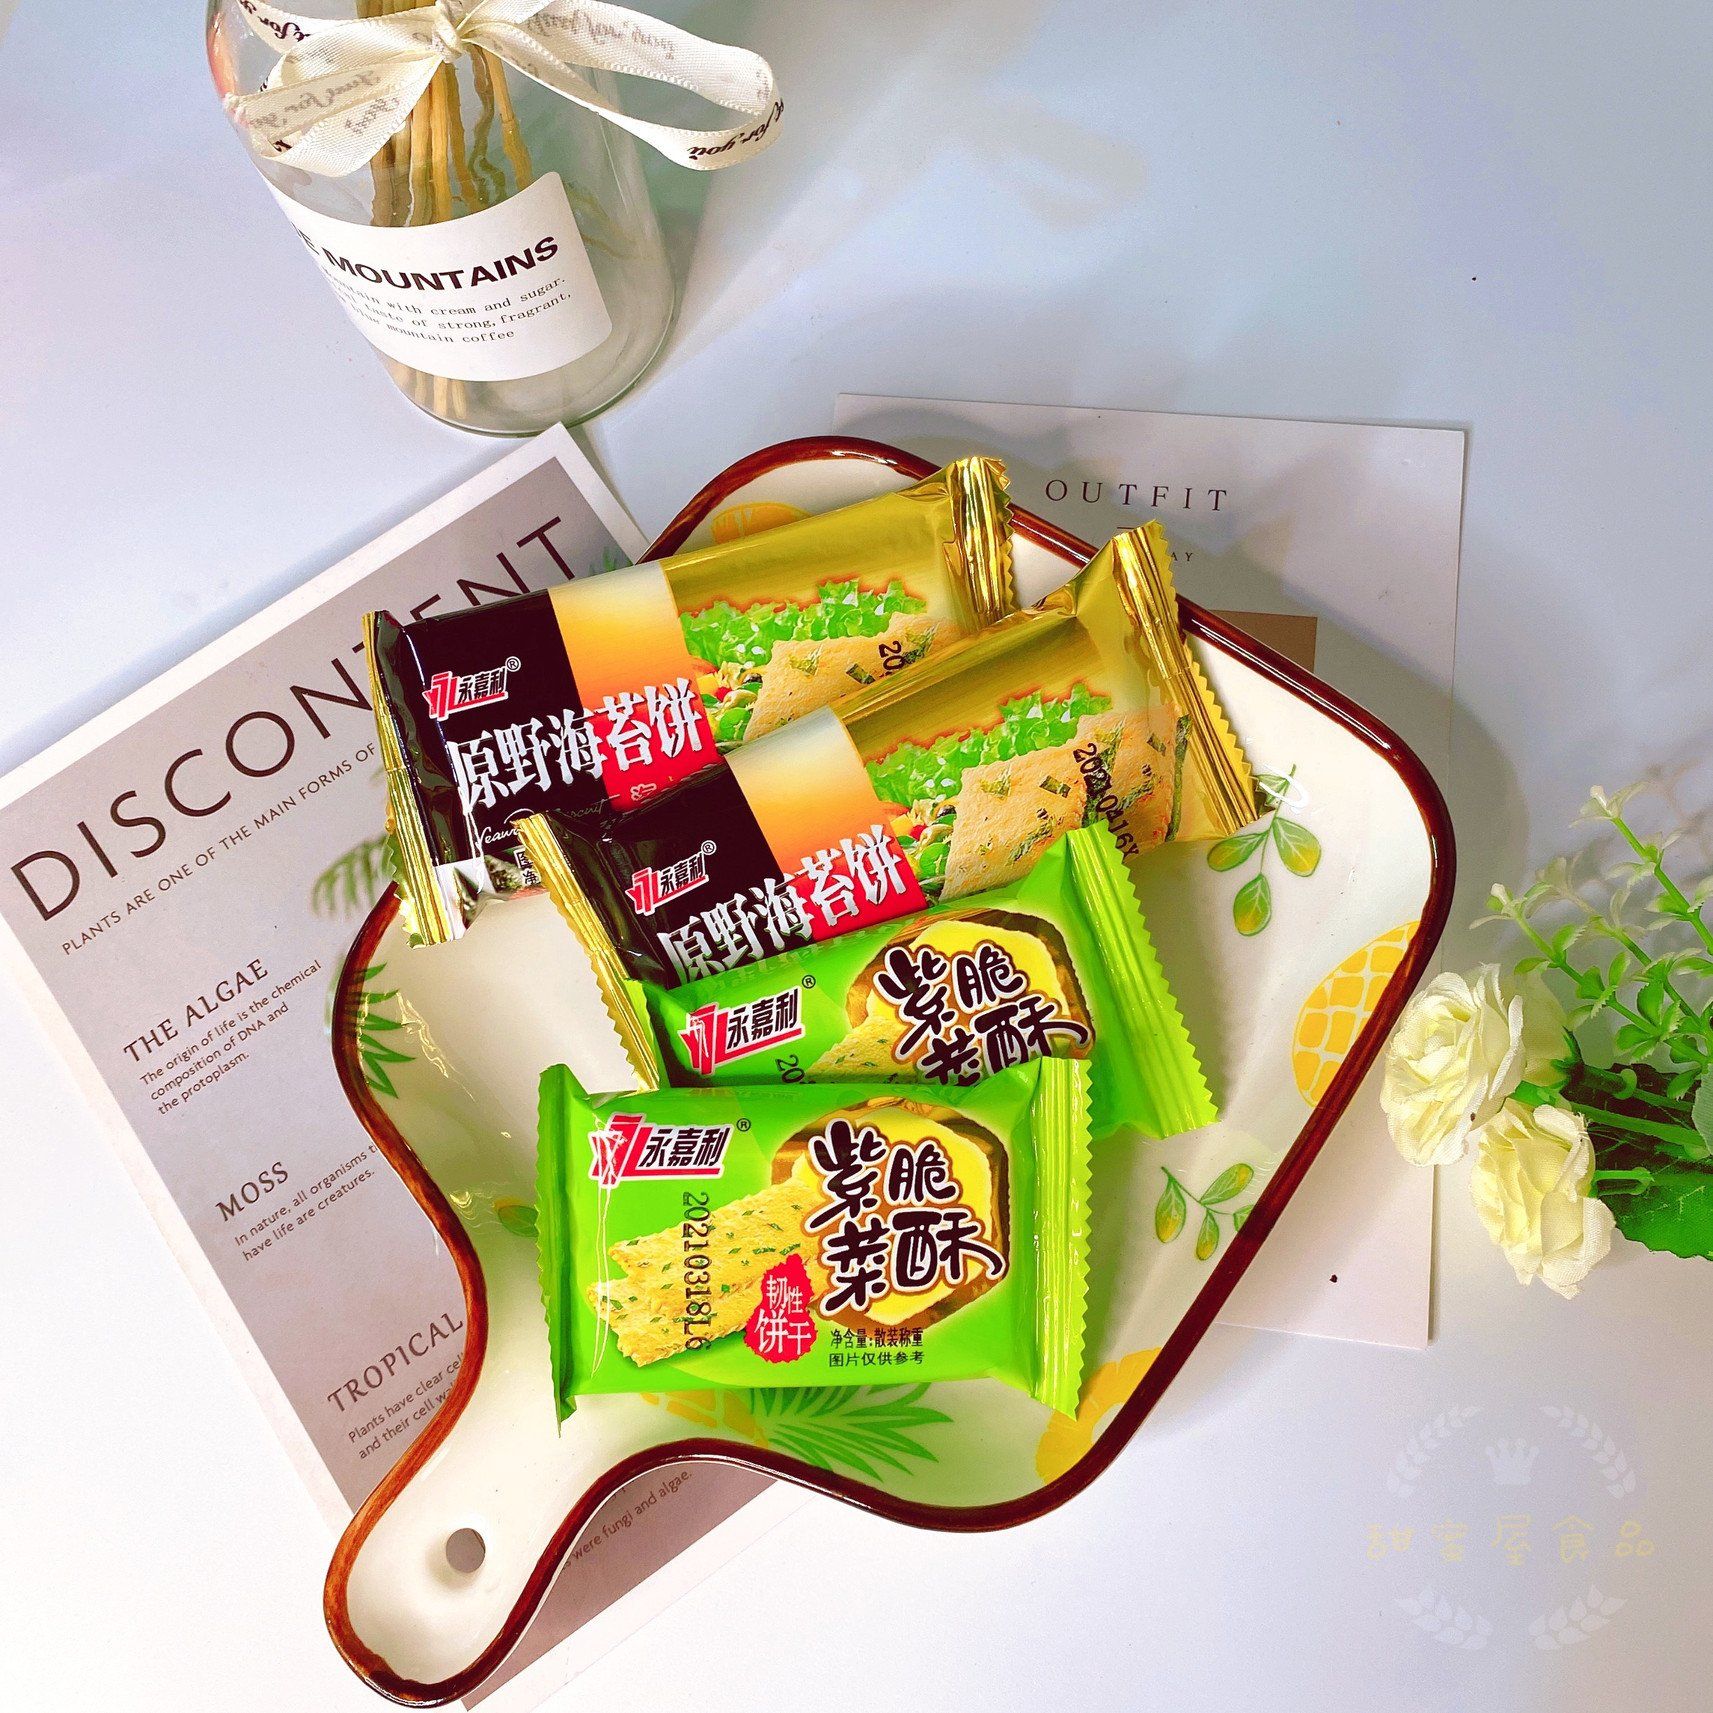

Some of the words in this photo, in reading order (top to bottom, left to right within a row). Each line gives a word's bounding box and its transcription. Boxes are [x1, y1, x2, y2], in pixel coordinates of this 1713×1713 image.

[322, 236, 559, 291] MOUNTAINS
[387, 302, 422, 314] with
[430, 306, 477, 316] cream
[484, 298, 511, 312] and
[520, 278, 566, 303] sugar.
[411, 318, 428, 327] of
[387, 323, 454, 343] mountain
[462, 330, 515, 343] coffee
[1045, 478, 1230, 513] OUTFIT
[457, 666, 507, 705] 永嘉利
[446, 677, 703, 815] 原野海苔饼
[61, 910, 122, 956] PLANTS
[126, 888, 156, 915] ARE
[158, 863, 194, 892] ONE
[195, 846, 218, 868] OF
[219, 825, 252, 850] THE
[253, 796, 297, 830] MAIN
[298, 759, 353, 801] FORMS
[355, 742, 377, 763] OF
[659, 852, 707, 897] 永嘉利
[656, 824, 908, 985] 原野海苔饼
[123, 1018, 179, 1062] THE
[185, 958, 269, 1028] ALGAE
[140, 1067, 163, 1086] The
[166, 1043, 200, 1070] origin
[201, 1030, 214, 1047] of
[216, 1018, 237, 1037] life
[237, 1010, 249, 1022] is
[249, 996, 270, 1014] the
[271, 959, 323, 999] chemical
[726, 985, 800, 1051] 永嘉利
[150, 1049, 222, 1101] composition
[223, 1036, 237, 1052] of
[238, 1020, 266, 1042] DNA
[267, 1001, 290, 1023] and
[158, 1098, 180, 1116] the
[181, 1052, 251, 1104] protoplasm.
[637, 1122, 729, 1169] 永嘉利
[215, 1161, 289, 1222] MOSS
[234, 1233, 249, 1247] In
[250, 1205, 292, 1237] nature,
[292, 1190, 309, 1208] all
[309, 1151, 368, 1196] organisms
[242, 1237, 273, 1262] have
[273, 1223, 295, 1241] life
[297, 1208, 317, 1226] are
[317, 1169, 376, 1211] creatures.
[766, 1274, 804, 1315] 韧性
[327, 1312, 464, 1413] TROPICAL
[754, 1308, 812, 1356] 饼干
[828, 1350, 925, 1368] 图片仅供参考
[348, 1415, 386, 1444] Plants
[385, 1393, 415, 1418] have
[415, 1370, 445, 1396] clear
[358, 1435, 382, 1460] and
[381, 1416, 411, 1442] their
[412, 1398, 436, 1421] cell
[571, 1535, 602, 1561] were
[601, 1508, 634, 1540] fungi
[634, 1491, 658, 1515] and
[657, 1469, 693, 1499] algae.
